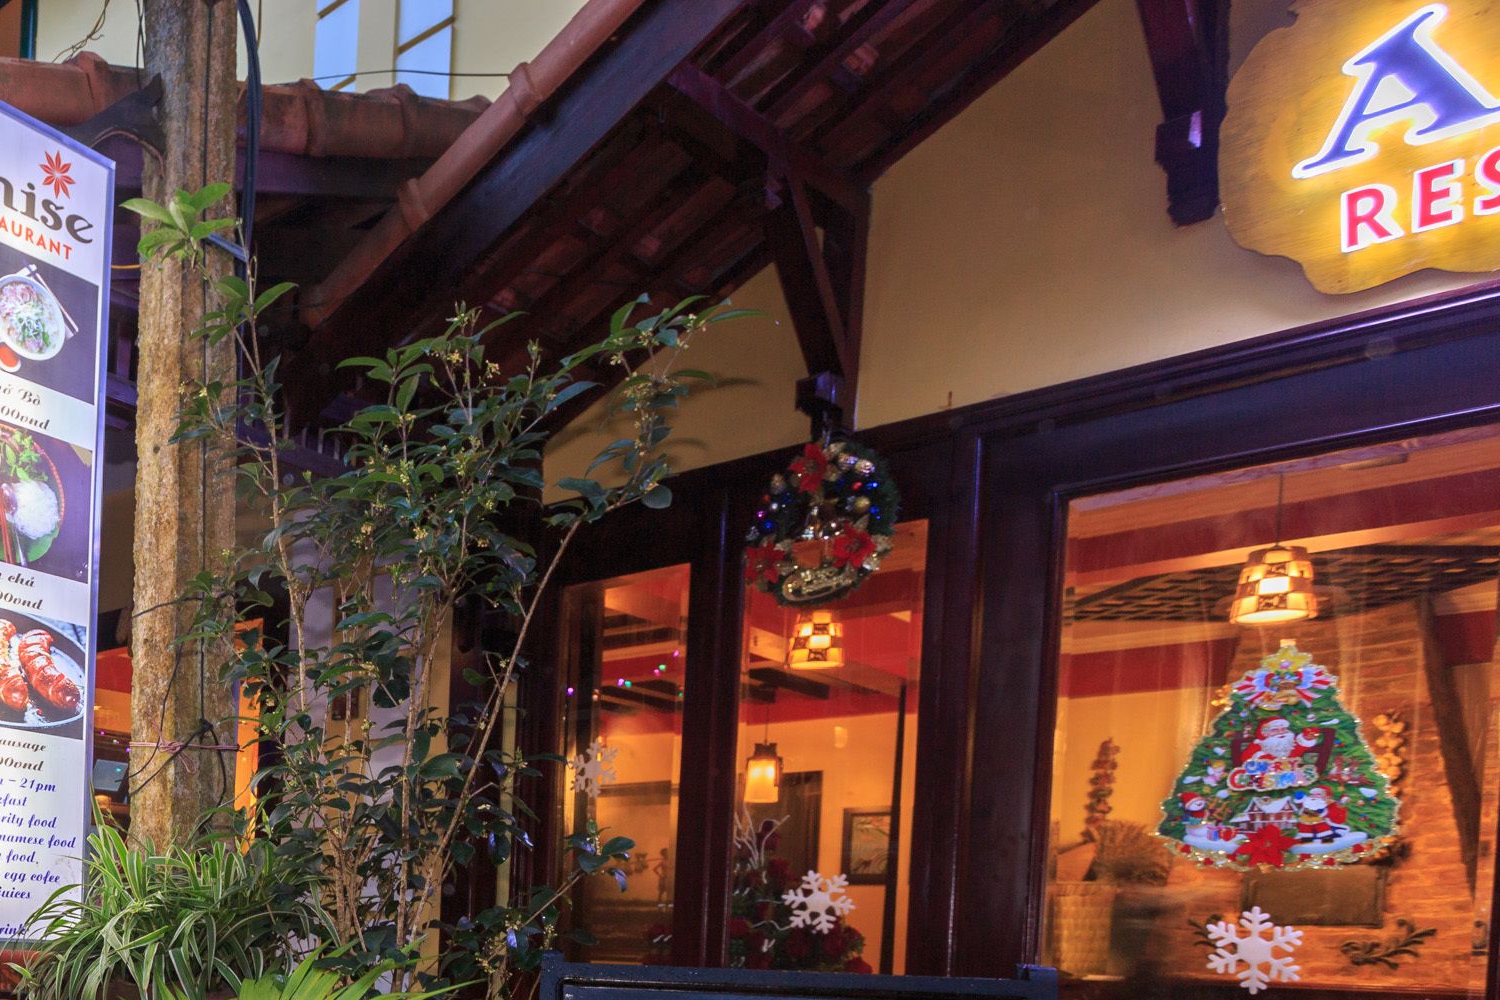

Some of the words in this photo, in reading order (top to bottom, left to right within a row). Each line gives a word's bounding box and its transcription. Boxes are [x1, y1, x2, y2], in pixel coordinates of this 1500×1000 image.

[20, 778, 57, 793] 21pm
[27, 814, 57, 829] food
[47, 835, 77, 849] food
[4, 872, 27, 884] egg
